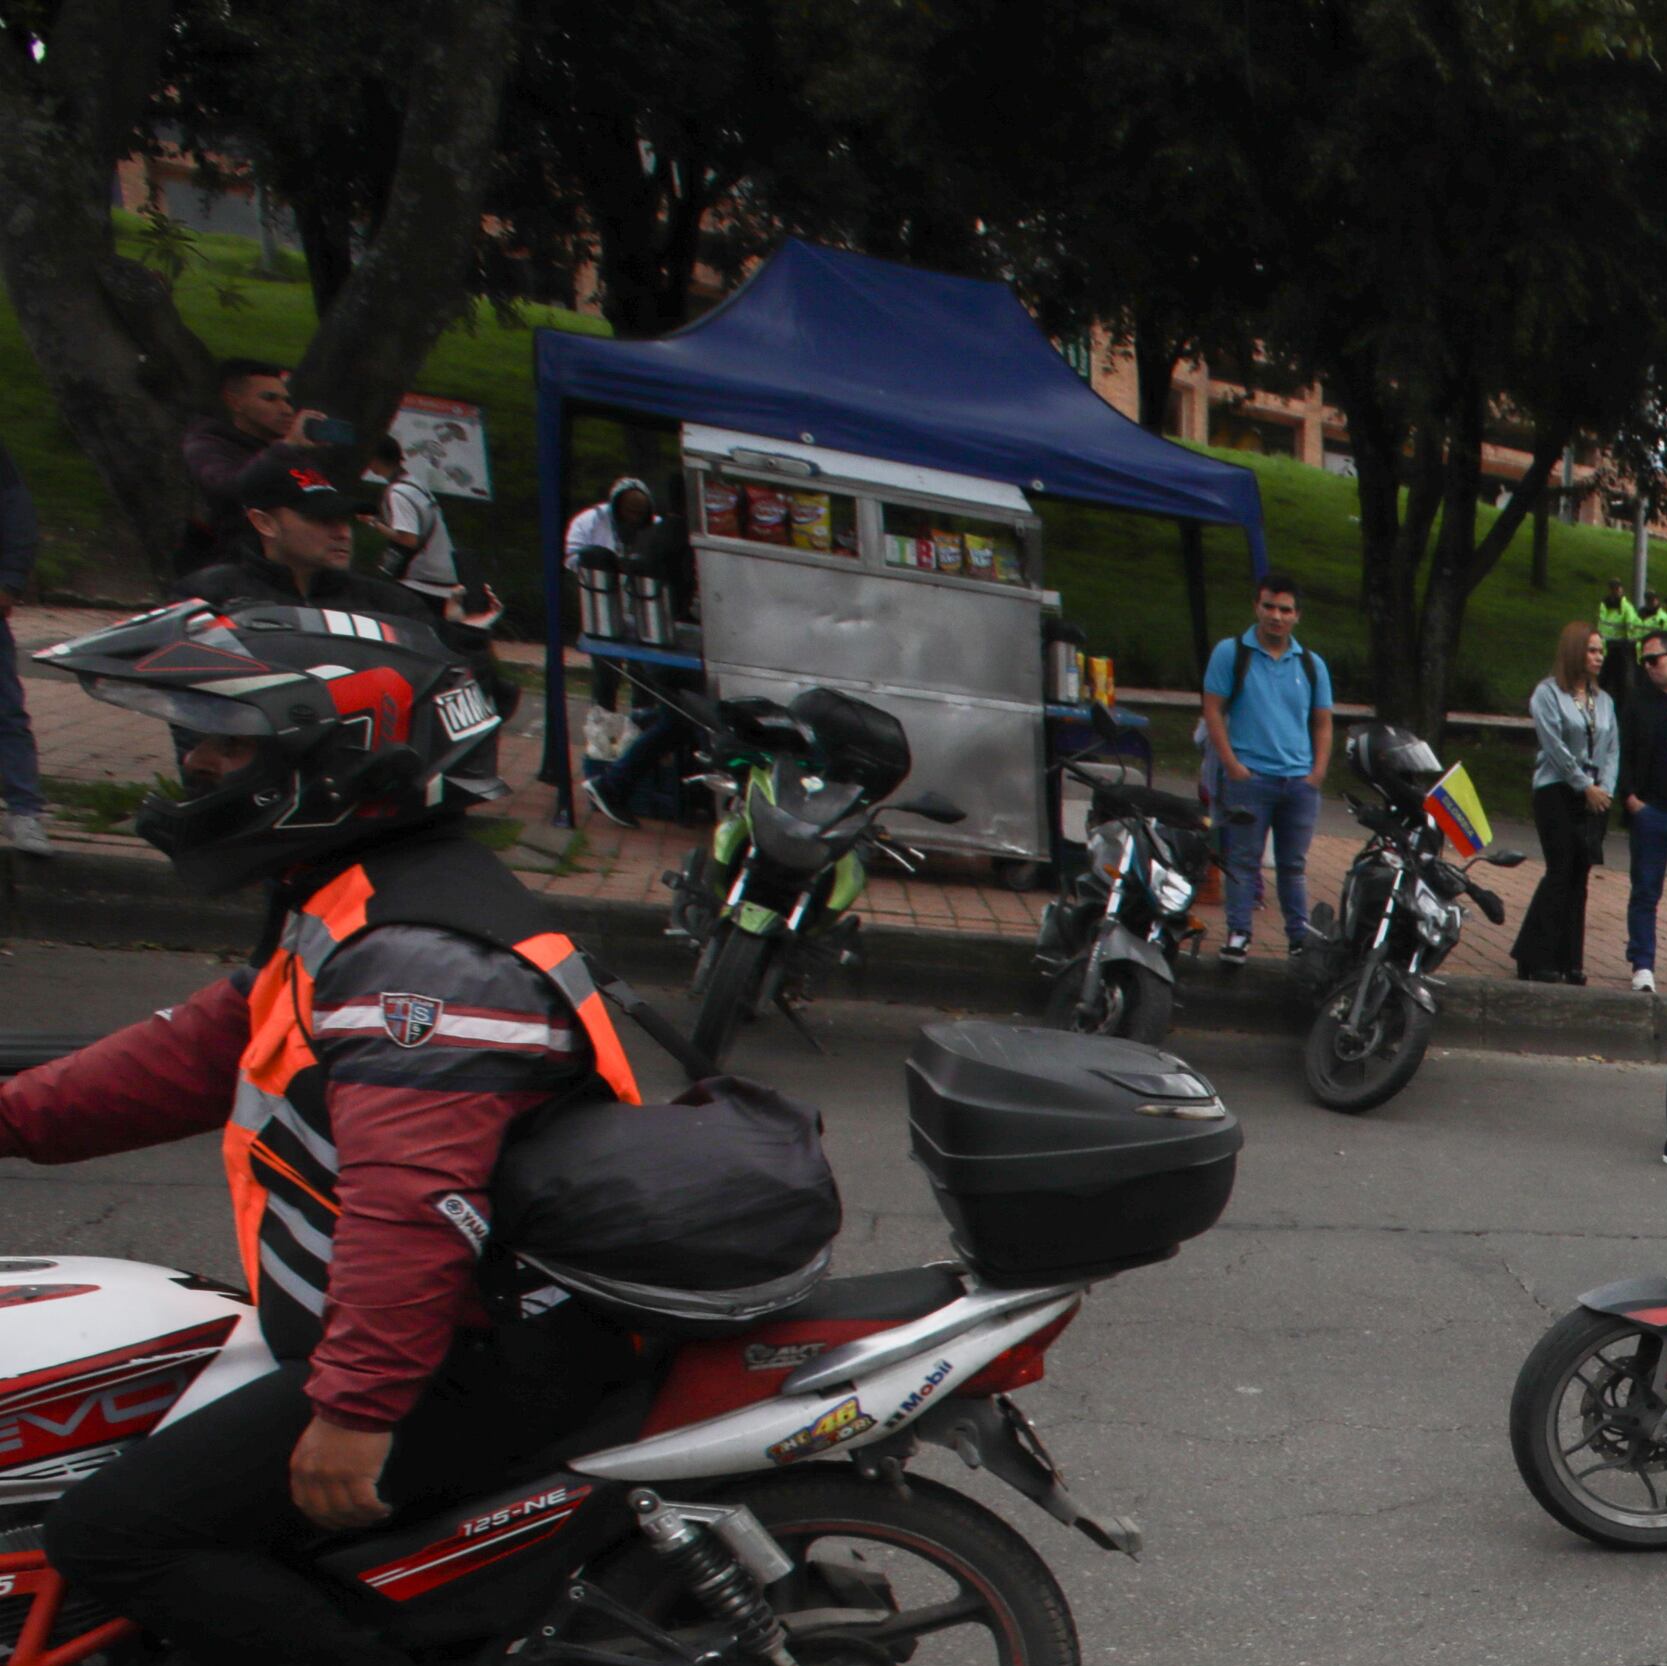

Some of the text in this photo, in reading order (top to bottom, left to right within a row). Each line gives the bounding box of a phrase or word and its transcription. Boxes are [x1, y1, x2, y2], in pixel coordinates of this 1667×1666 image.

[461, 1210, 489, 1242] YAM
[901, 1359, 954, 1413] Mobil
[810, 1398, 860, 1438] 46
